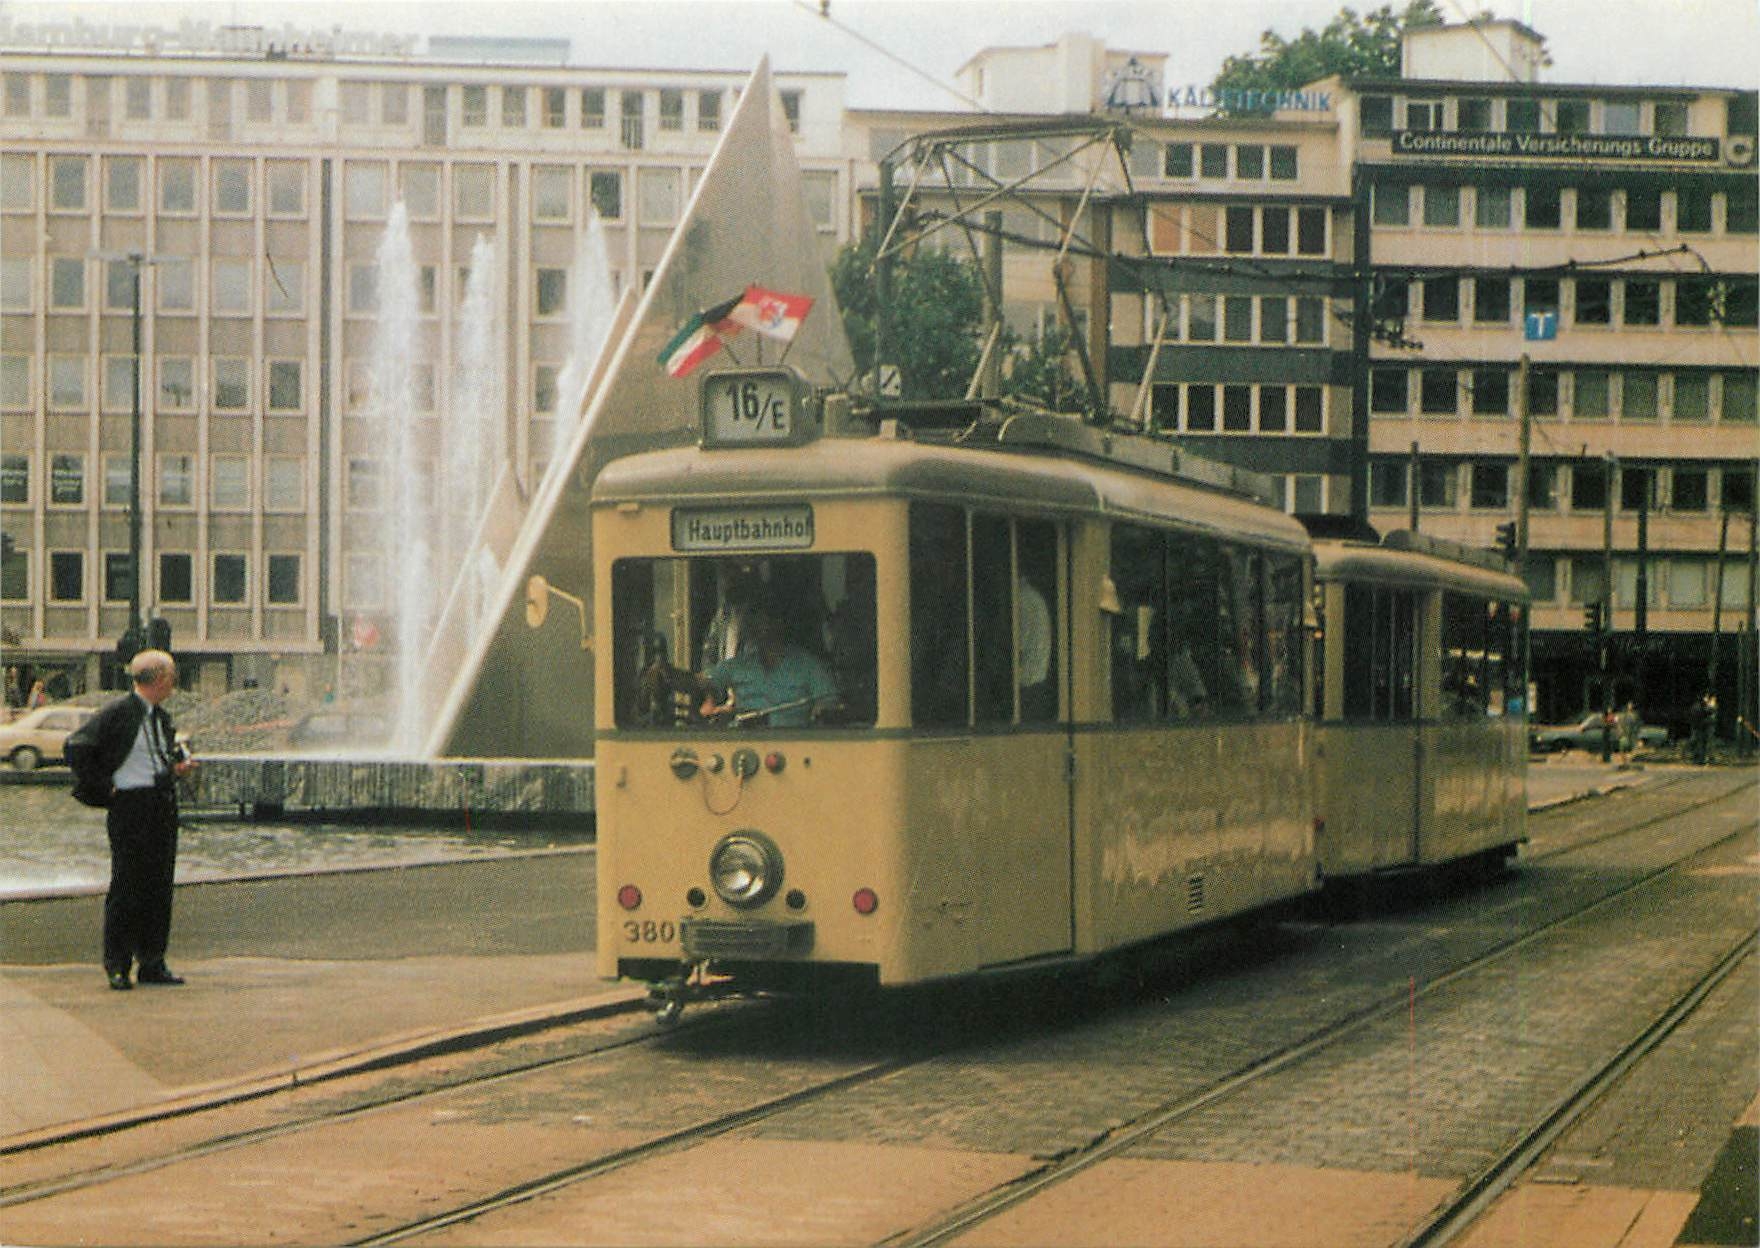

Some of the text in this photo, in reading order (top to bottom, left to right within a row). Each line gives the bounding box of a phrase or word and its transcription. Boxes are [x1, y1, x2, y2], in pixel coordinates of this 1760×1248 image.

[1400, 131, 1713, 157] Continentale Versicherungs Gruppe
[725, 381, 785, 431] 16/E
[688, 516, 812, 543] Hauptbahnhof
[623, 920, 675, 943] 380
